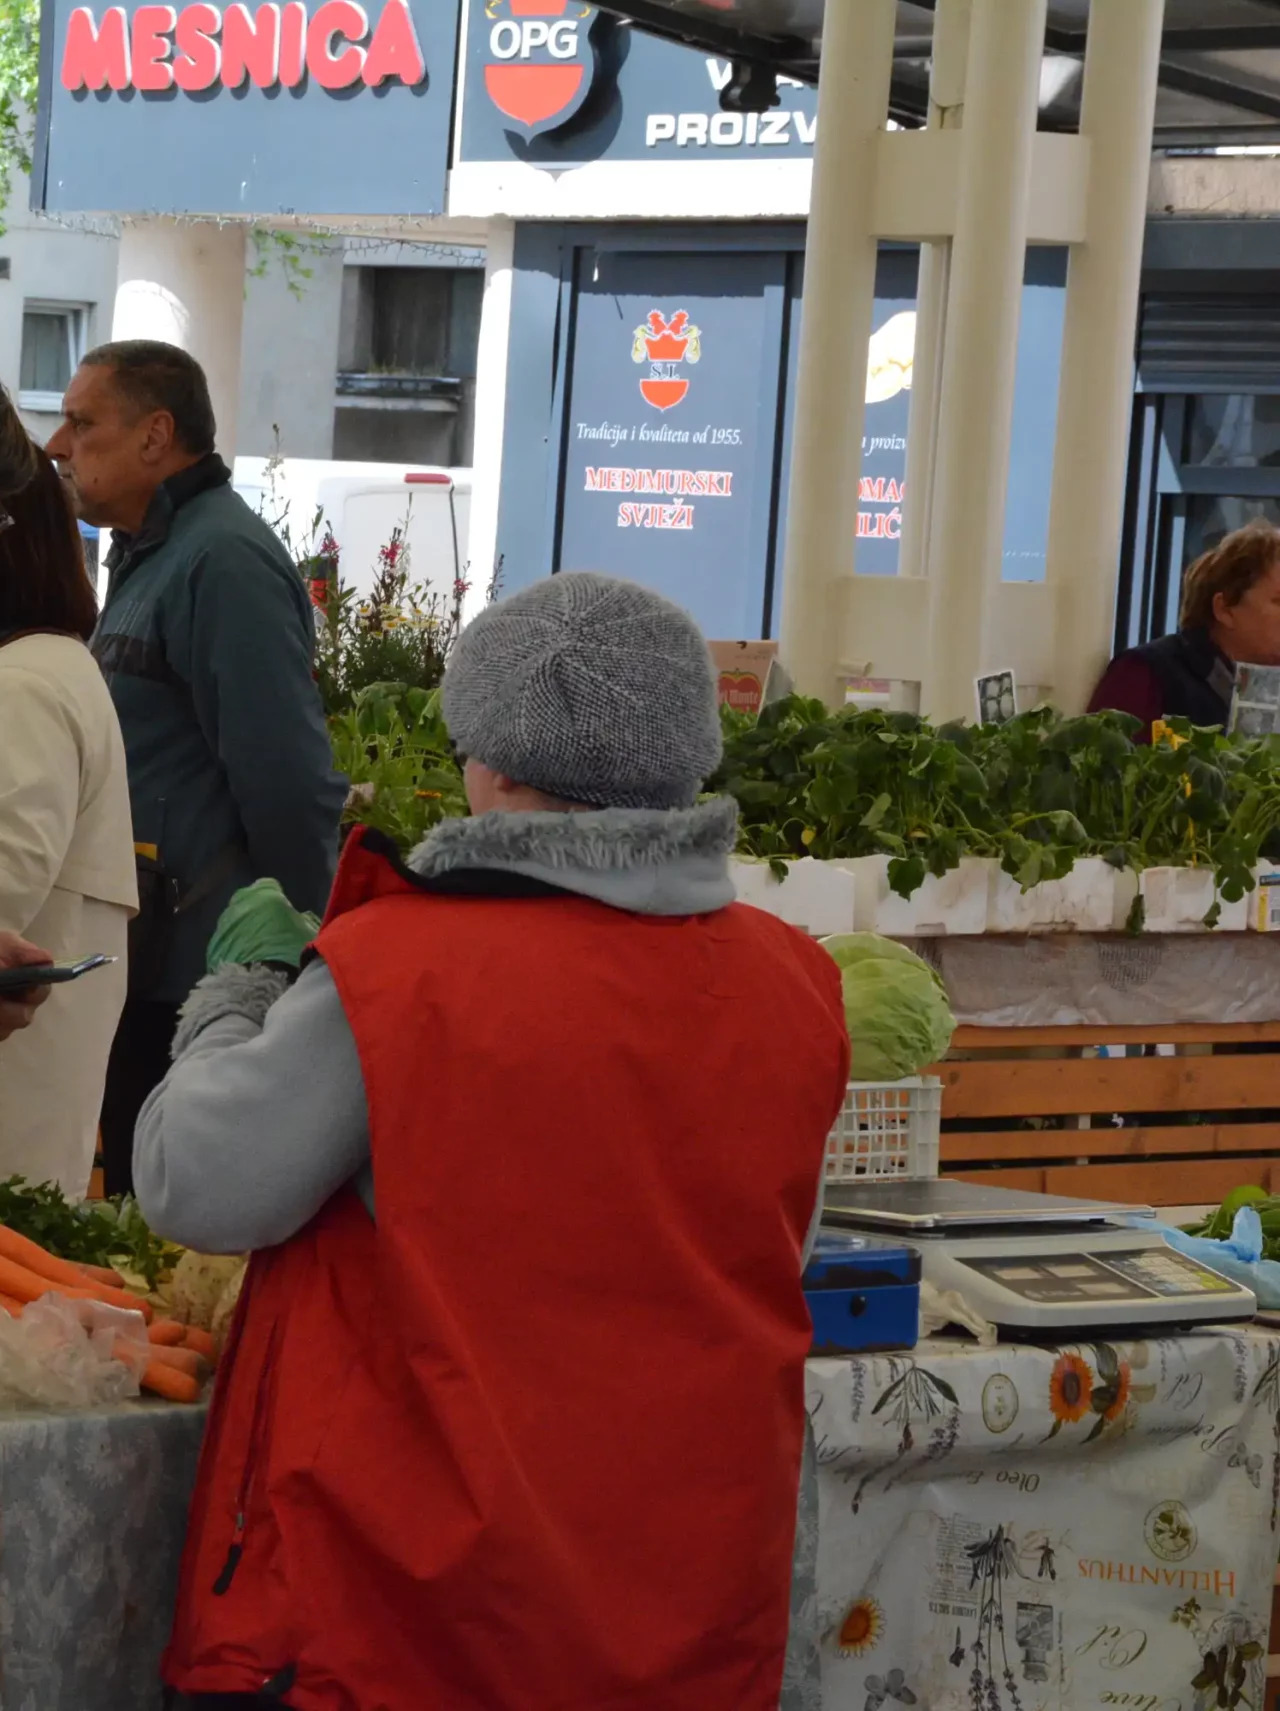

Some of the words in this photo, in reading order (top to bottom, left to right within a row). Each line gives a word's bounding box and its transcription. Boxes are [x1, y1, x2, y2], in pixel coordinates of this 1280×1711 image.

[61, 1, 426, 91] MESNICA
[489, 20, 580, 60] OPG
[577, 421, 628, 448] Tradicija
[631, 426, 636, 441] i
[638, 423, 690, 444] kvaliteta
[693, 425, 711, 444] od
[711, 428, 744, 445] 1955.
[585, 466, 733, 496] MEĐIMURSKI
[617, 498, 695, 530] SVJEŽI
[1078, 1558, 1236, 1598] HELIANTHUS
[1075, 1624, 1148, 1671] Oil
